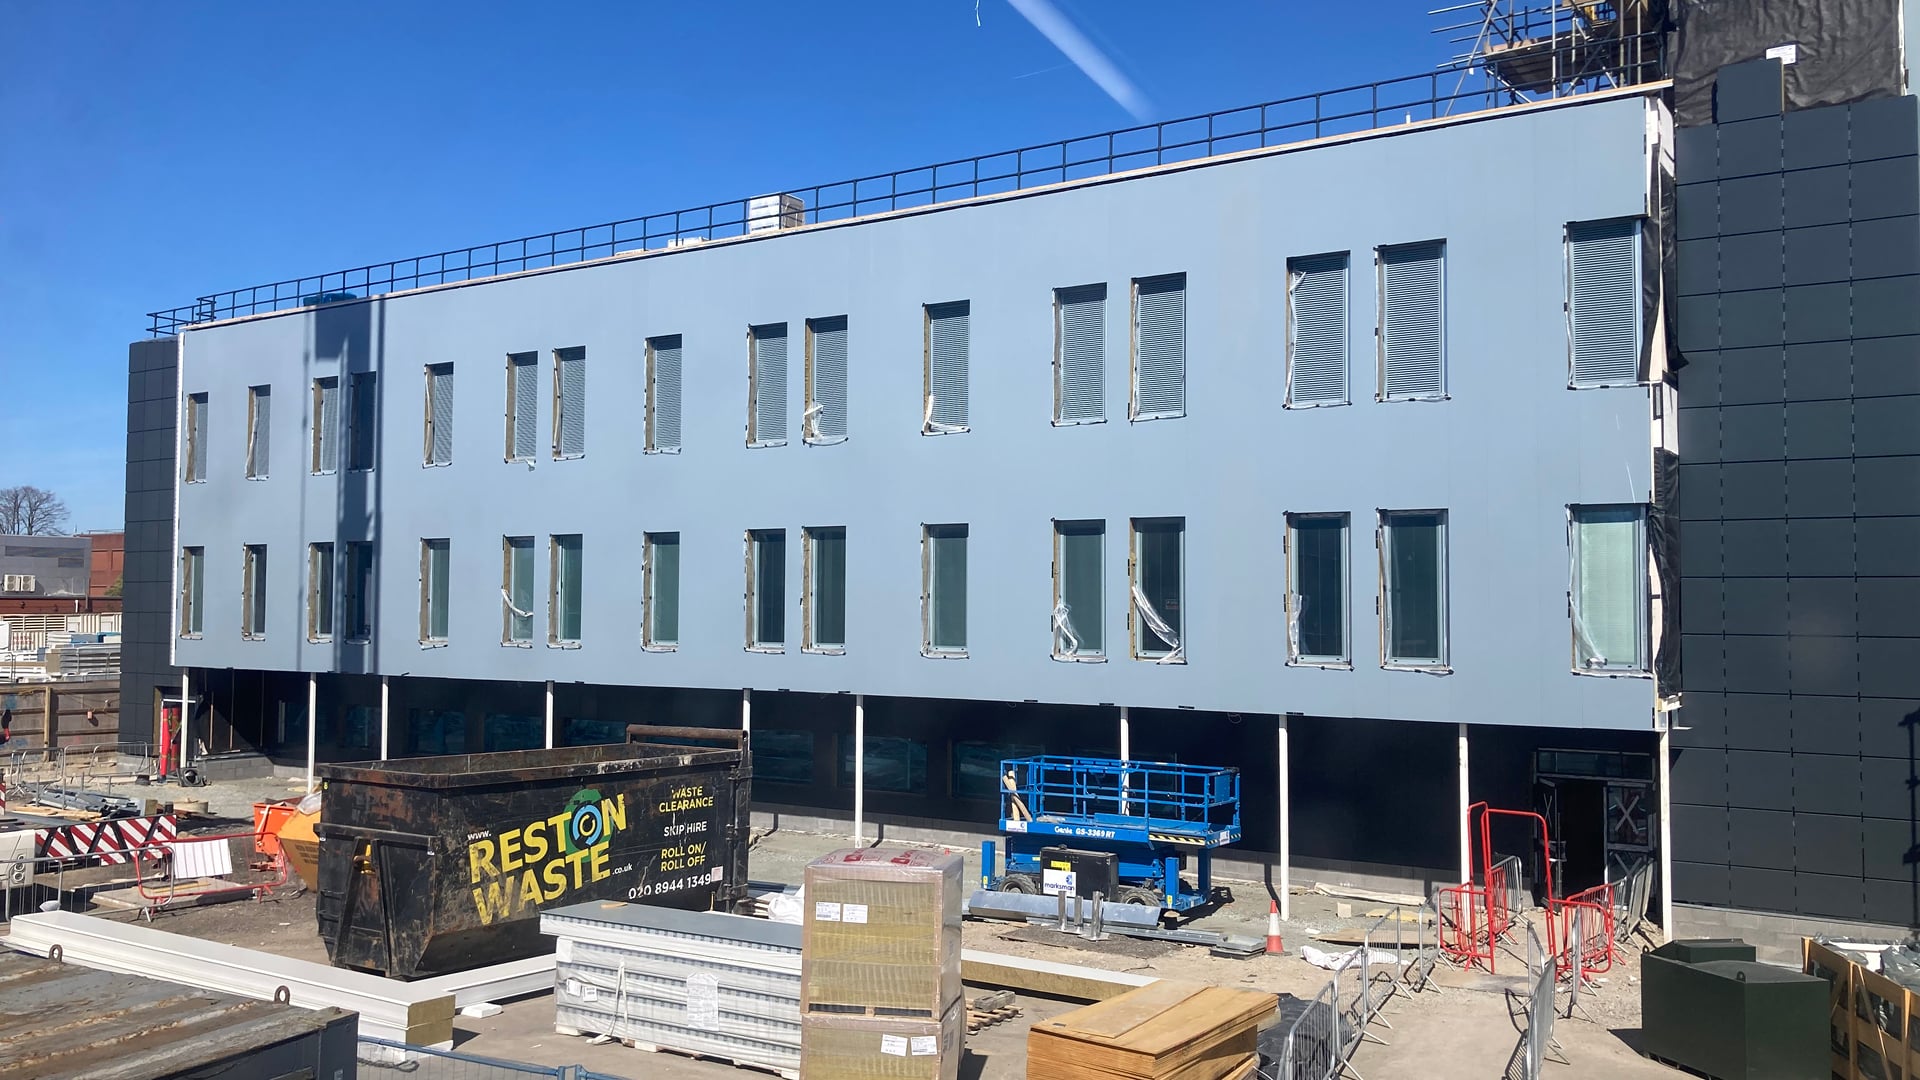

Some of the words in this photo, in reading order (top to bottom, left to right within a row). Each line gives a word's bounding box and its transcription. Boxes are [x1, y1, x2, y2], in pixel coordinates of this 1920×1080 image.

[672, 786, 703, 799] WASTE
[659, 797, 714, 812] CLEARANCE
[664, 824, 685, 837] SKIP
[686, 821, 707, 834] HIRE
[468, 794, 627, 884] RESTON
[661, 846, 686, 860] ROLL
[687, 841, 707, 855] ON/
[661, 858, 685, 872] ROLL
[687, 855, 706, 868] OFF
[472, 841, 611, 926] WASTE
[628, 885, 652, 900] 020
[654, 878, 684, 895] 8944
[686, 873, 711, 889] 1349
[1044, 882, 1075, 891] marksman
